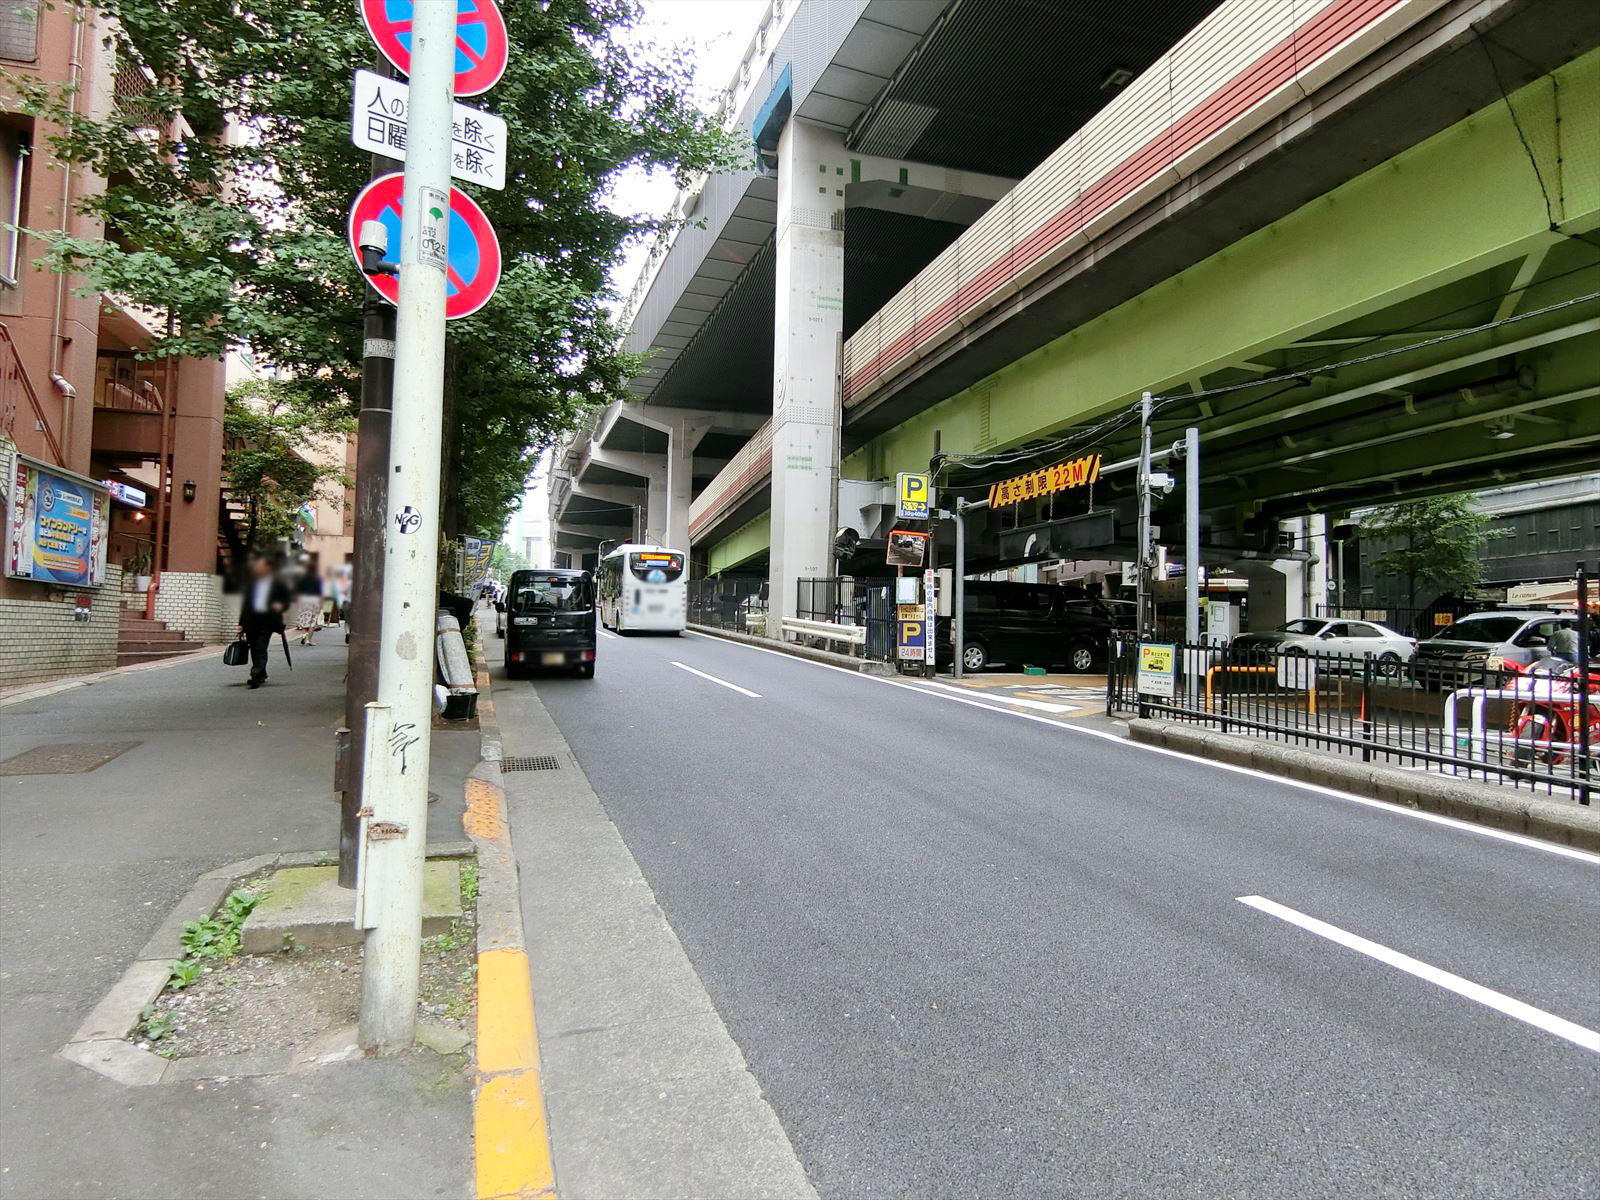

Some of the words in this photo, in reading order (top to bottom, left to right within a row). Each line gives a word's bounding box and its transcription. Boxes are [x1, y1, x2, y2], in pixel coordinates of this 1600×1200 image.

[907, 477, 923, 499] P
[1000, 474, 1048, 501] 高さ制限
[902, 622, 922, 644] P
[901, 648, 922, 658] 24時間
